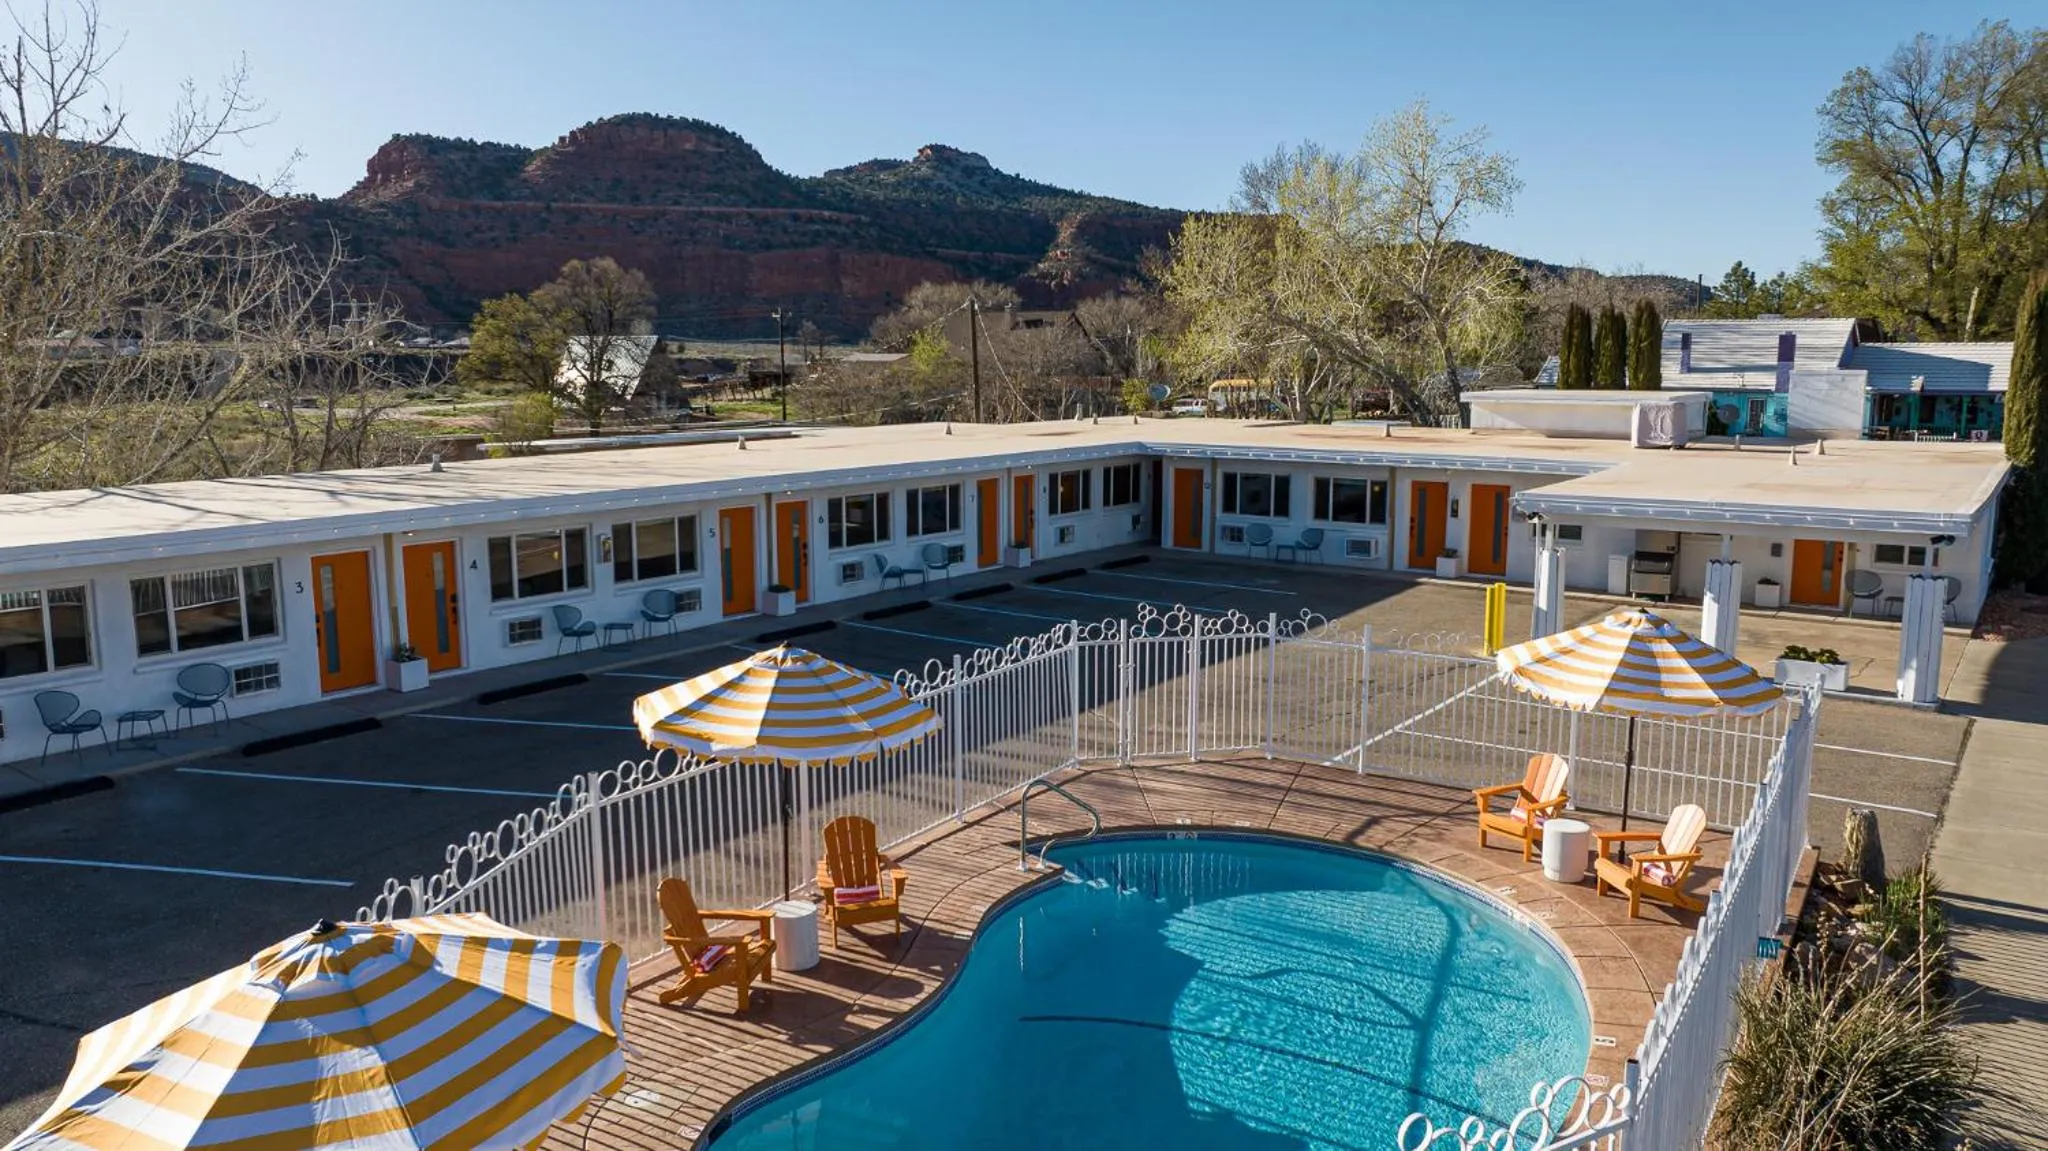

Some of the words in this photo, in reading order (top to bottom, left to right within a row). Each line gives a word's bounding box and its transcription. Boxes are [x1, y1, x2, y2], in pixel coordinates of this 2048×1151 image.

[818, 515, 824, 524] 6
[709, 527, 716, 538] 5
[469, 559, 478, 570] 4
[295, 581, 303, 594] 3
